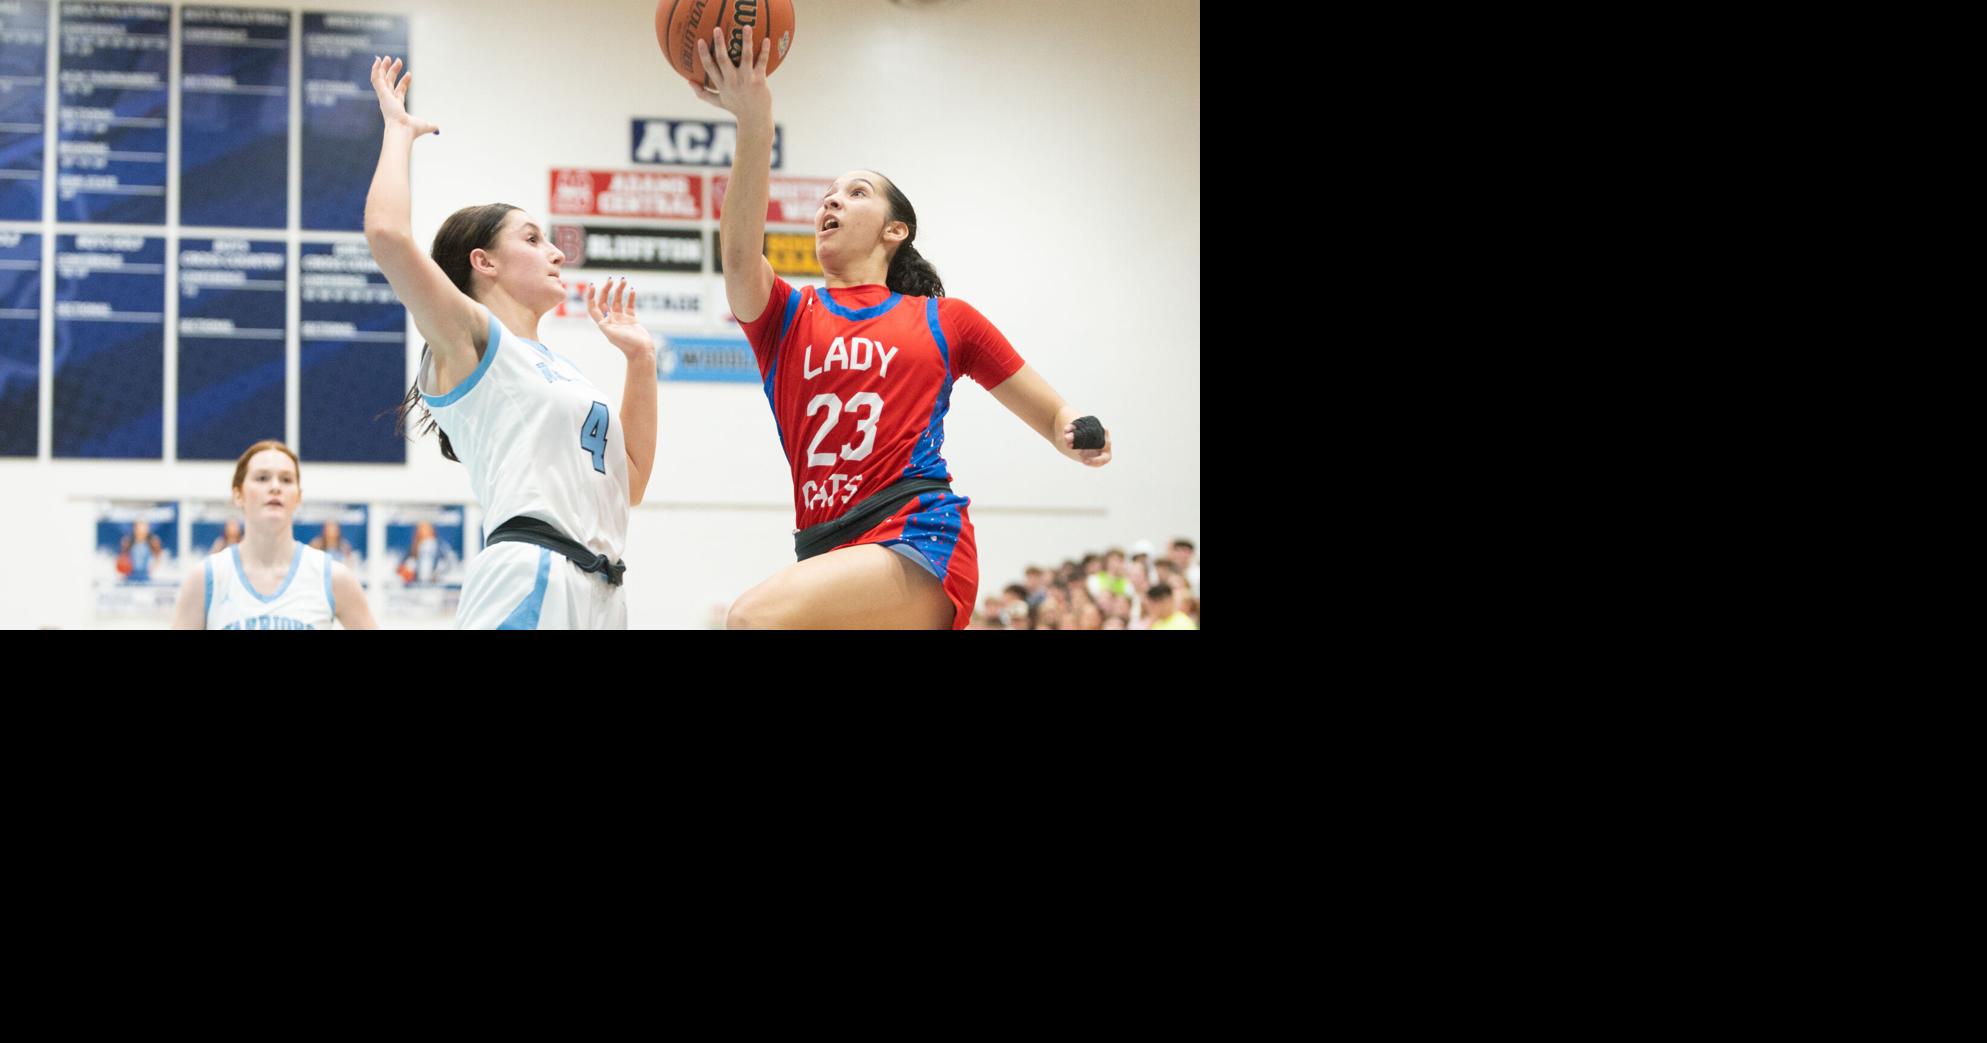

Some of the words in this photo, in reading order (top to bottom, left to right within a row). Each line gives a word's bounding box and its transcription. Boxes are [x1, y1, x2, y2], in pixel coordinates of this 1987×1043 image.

[682, 0, 708, 73] VOLUTION
[636, 121, 778, 166] ACA
[597, 192, 699, 215] CENTRAL
[611, 174, 690, 193] ADAMS
[586, 234, 700, 261] BLUFFTON
[803, 336, 899, 380] LADY
[580, 400, 610, 475] 4
[806, 391, 885, 468] 23
[802, 473, 863, 511] CATS
